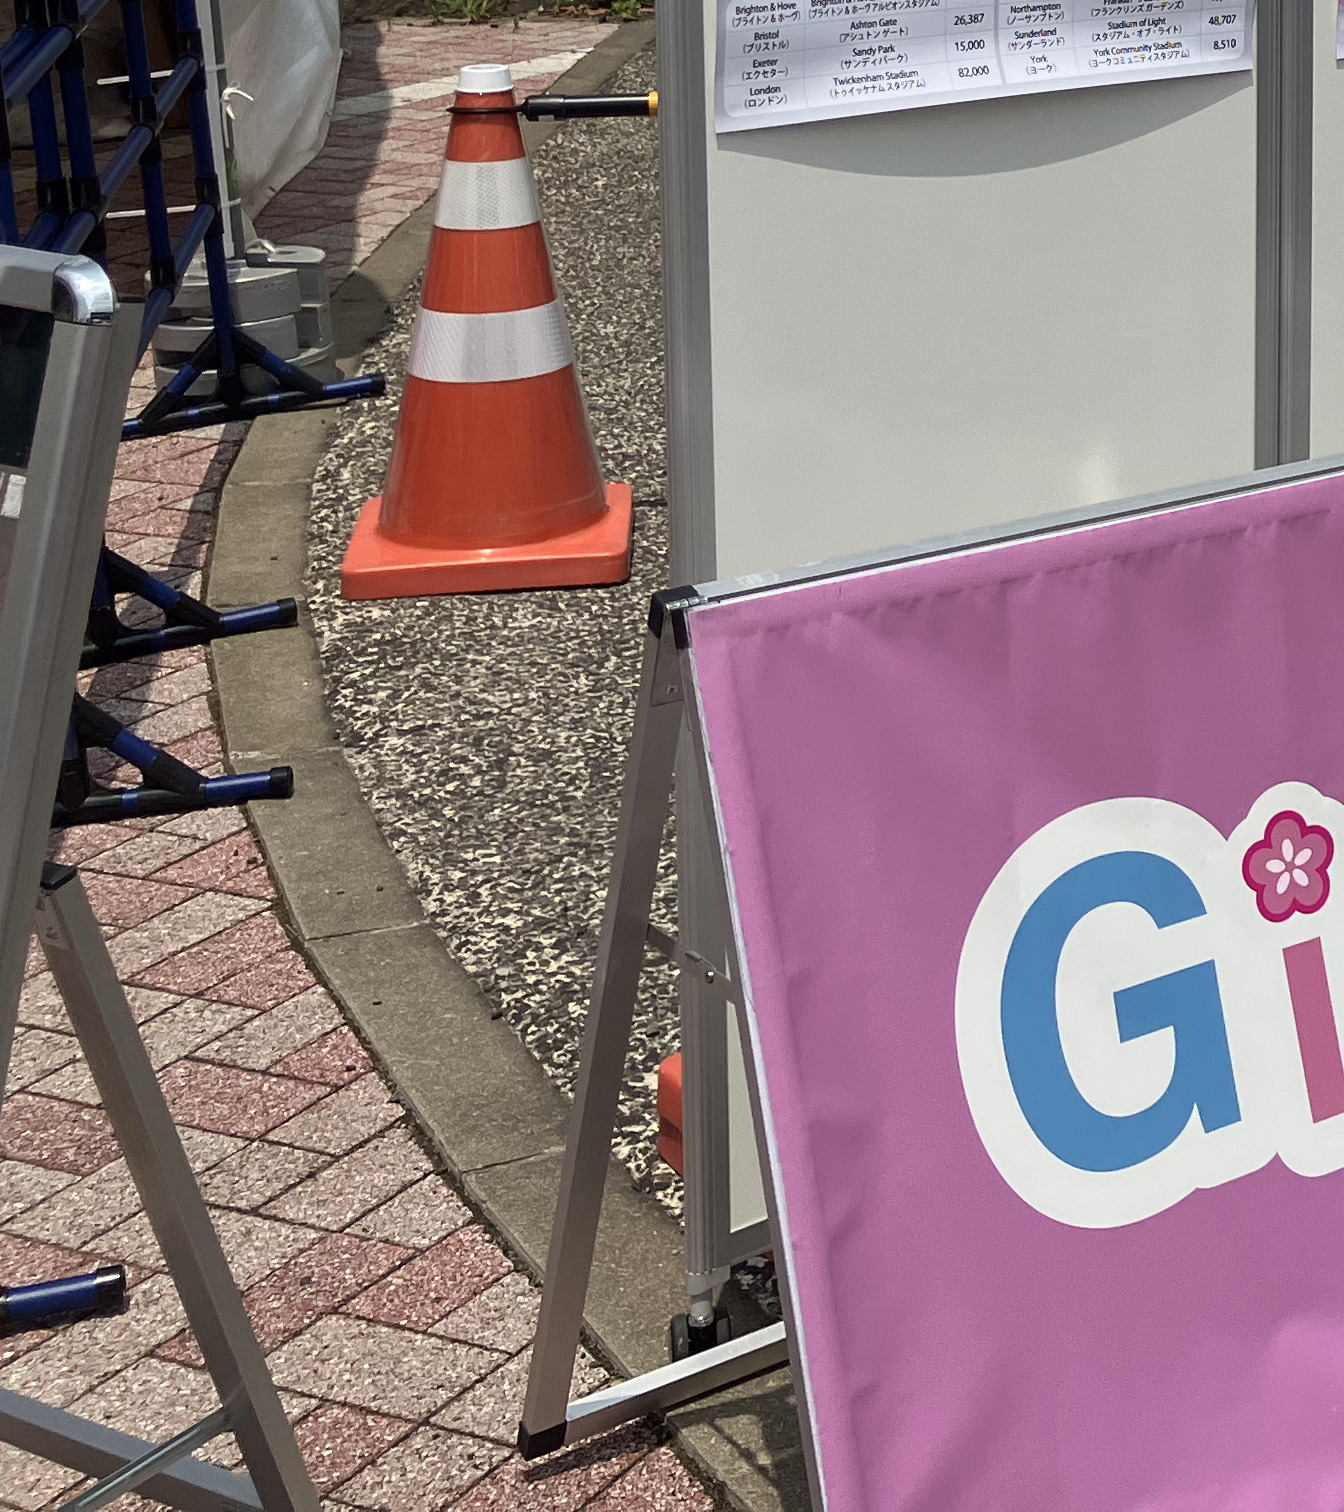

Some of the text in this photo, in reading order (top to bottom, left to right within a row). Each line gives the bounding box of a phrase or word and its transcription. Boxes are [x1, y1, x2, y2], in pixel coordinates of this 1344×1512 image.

[954, 14, 984, 26] 26,387
[1209, 15, 1236, 26] 48,707
[754, 30, 779, 40] Bristol
[955, 40, 985, 52] 15,000
[1213, 40, 1236, 50] 8,510
[958, 66, 989, 78] 82,000
[750, 85, 781, 95] London
